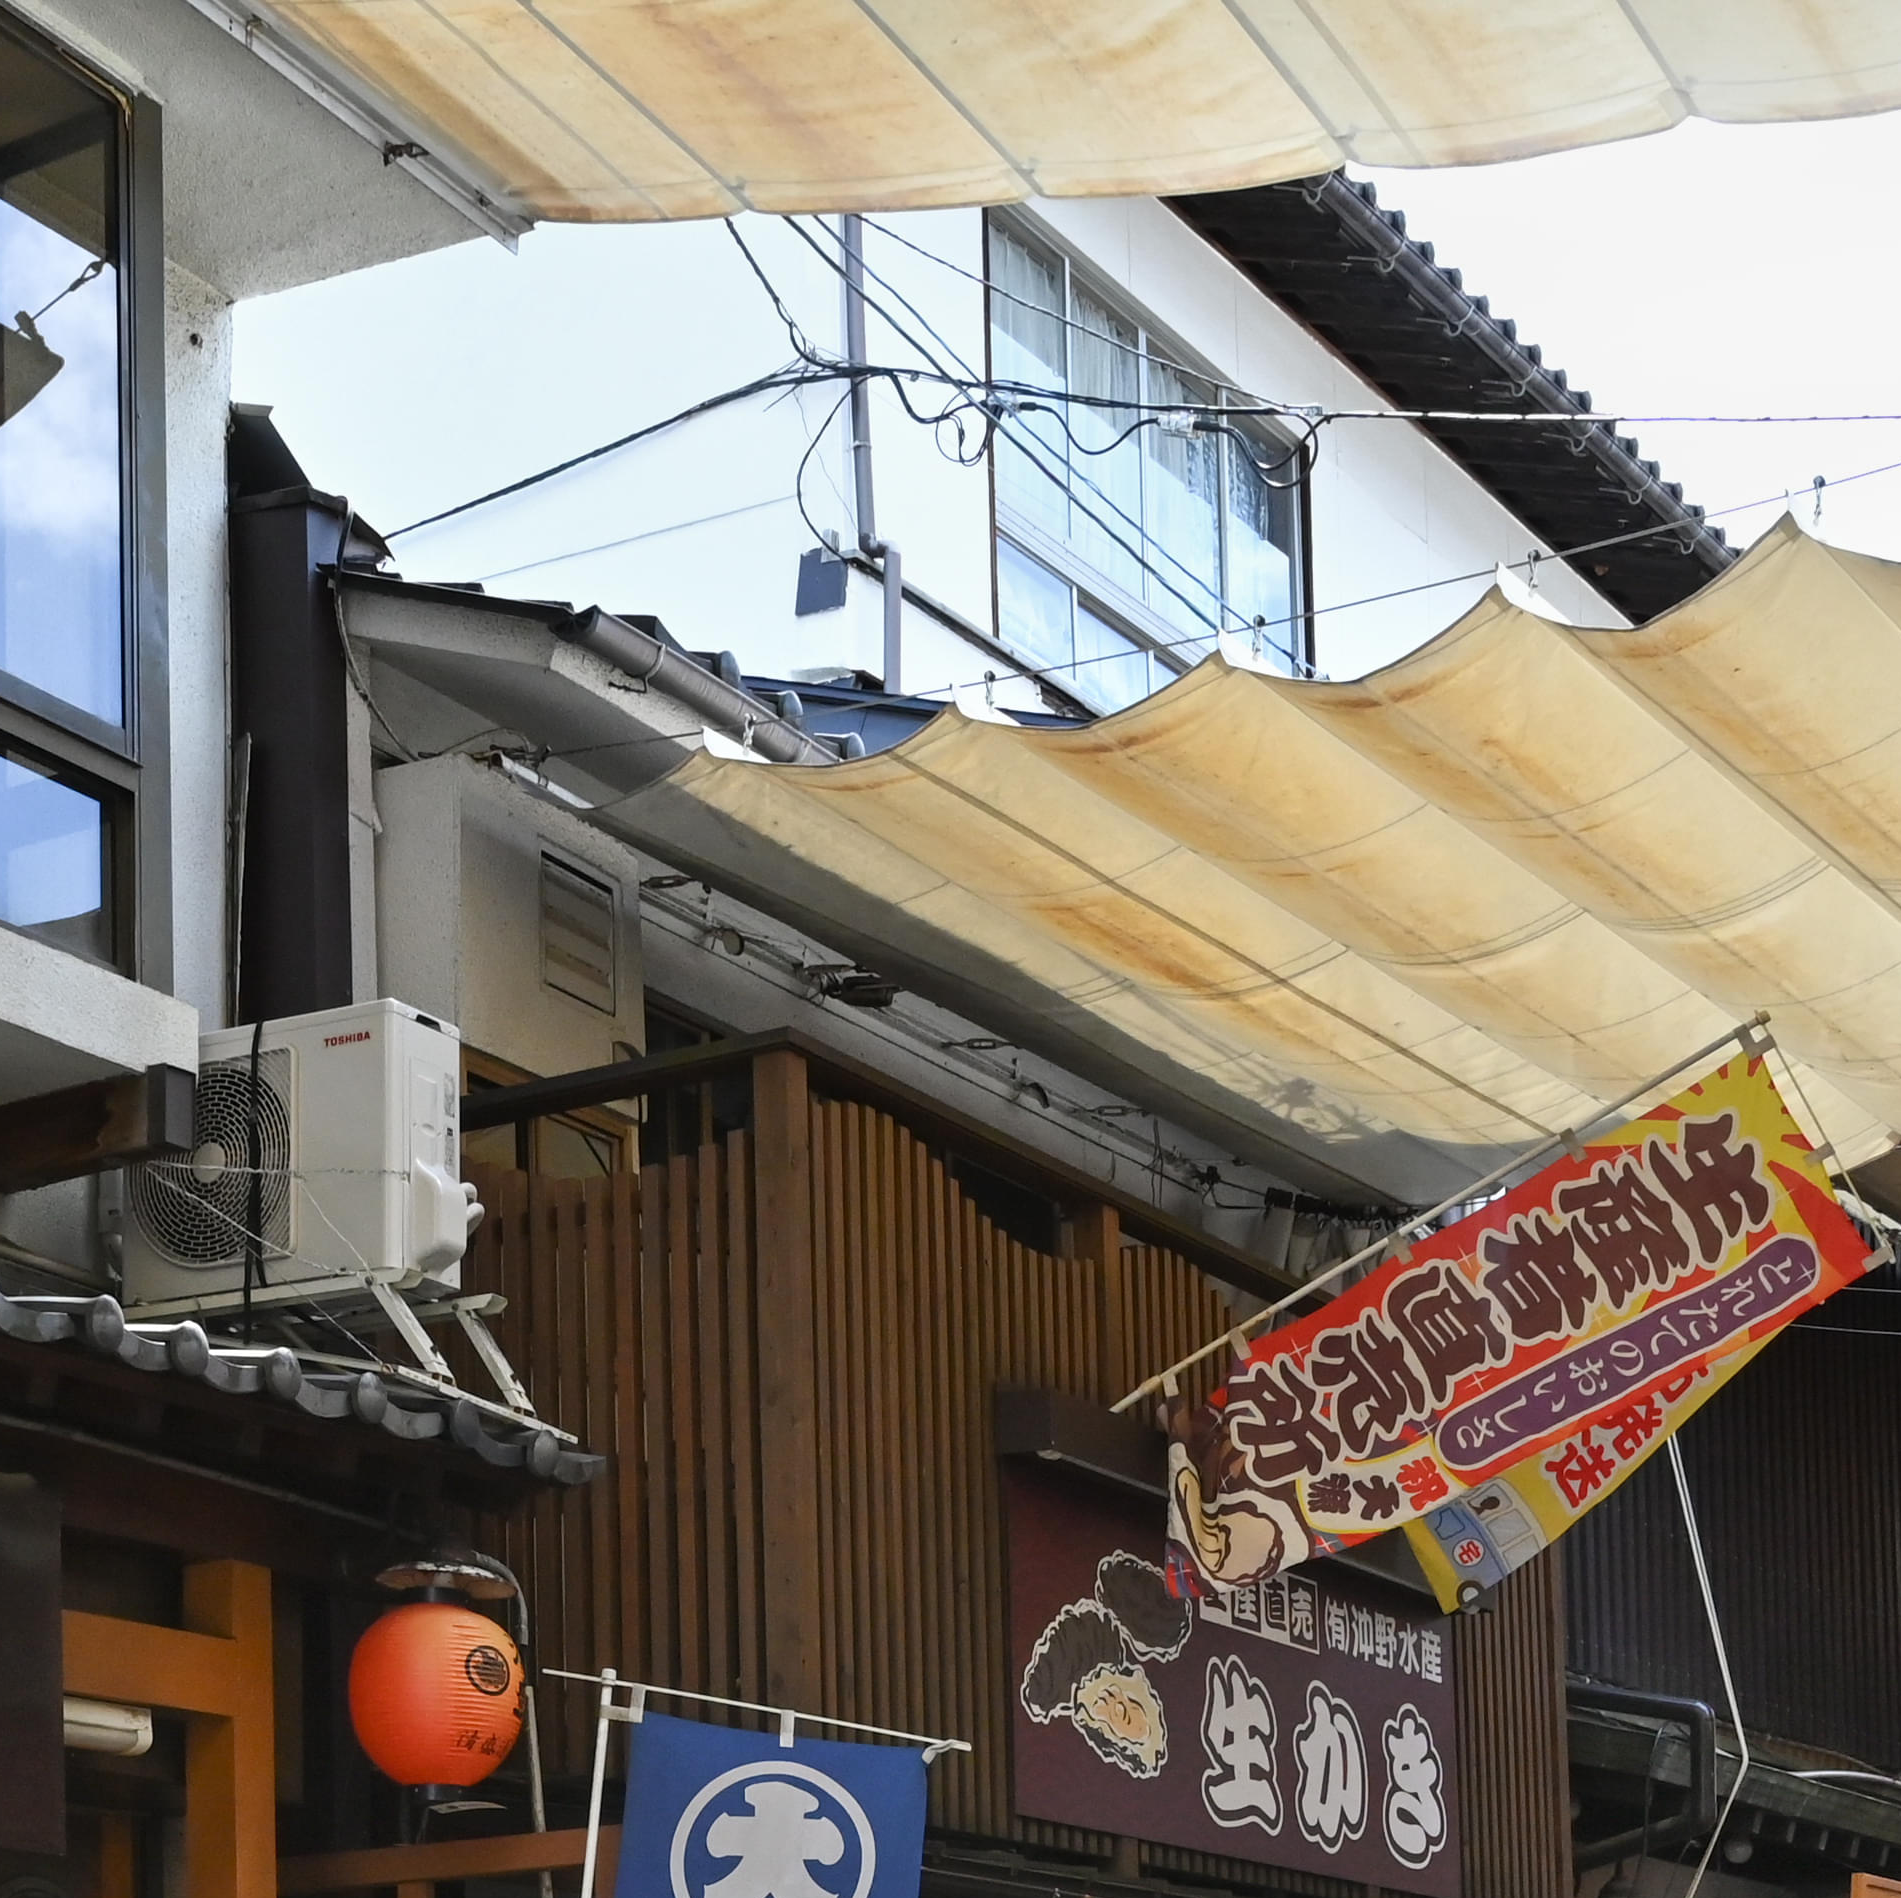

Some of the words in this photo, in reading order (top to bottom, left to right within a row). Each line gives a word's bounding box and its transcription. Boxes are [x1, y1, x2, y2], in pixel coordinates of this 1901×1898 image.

[324, 1031, 371, 1048] TOSHIBA
[1231, 1112, 1771, 1487] 生産者直売所
[1456, 1253, 1796, 1450] とれたてのおいしさ
[1325, 1595, 1443, 1684] (有)沖野水産
[1202, 1658, 1447, 1866] 生かき
